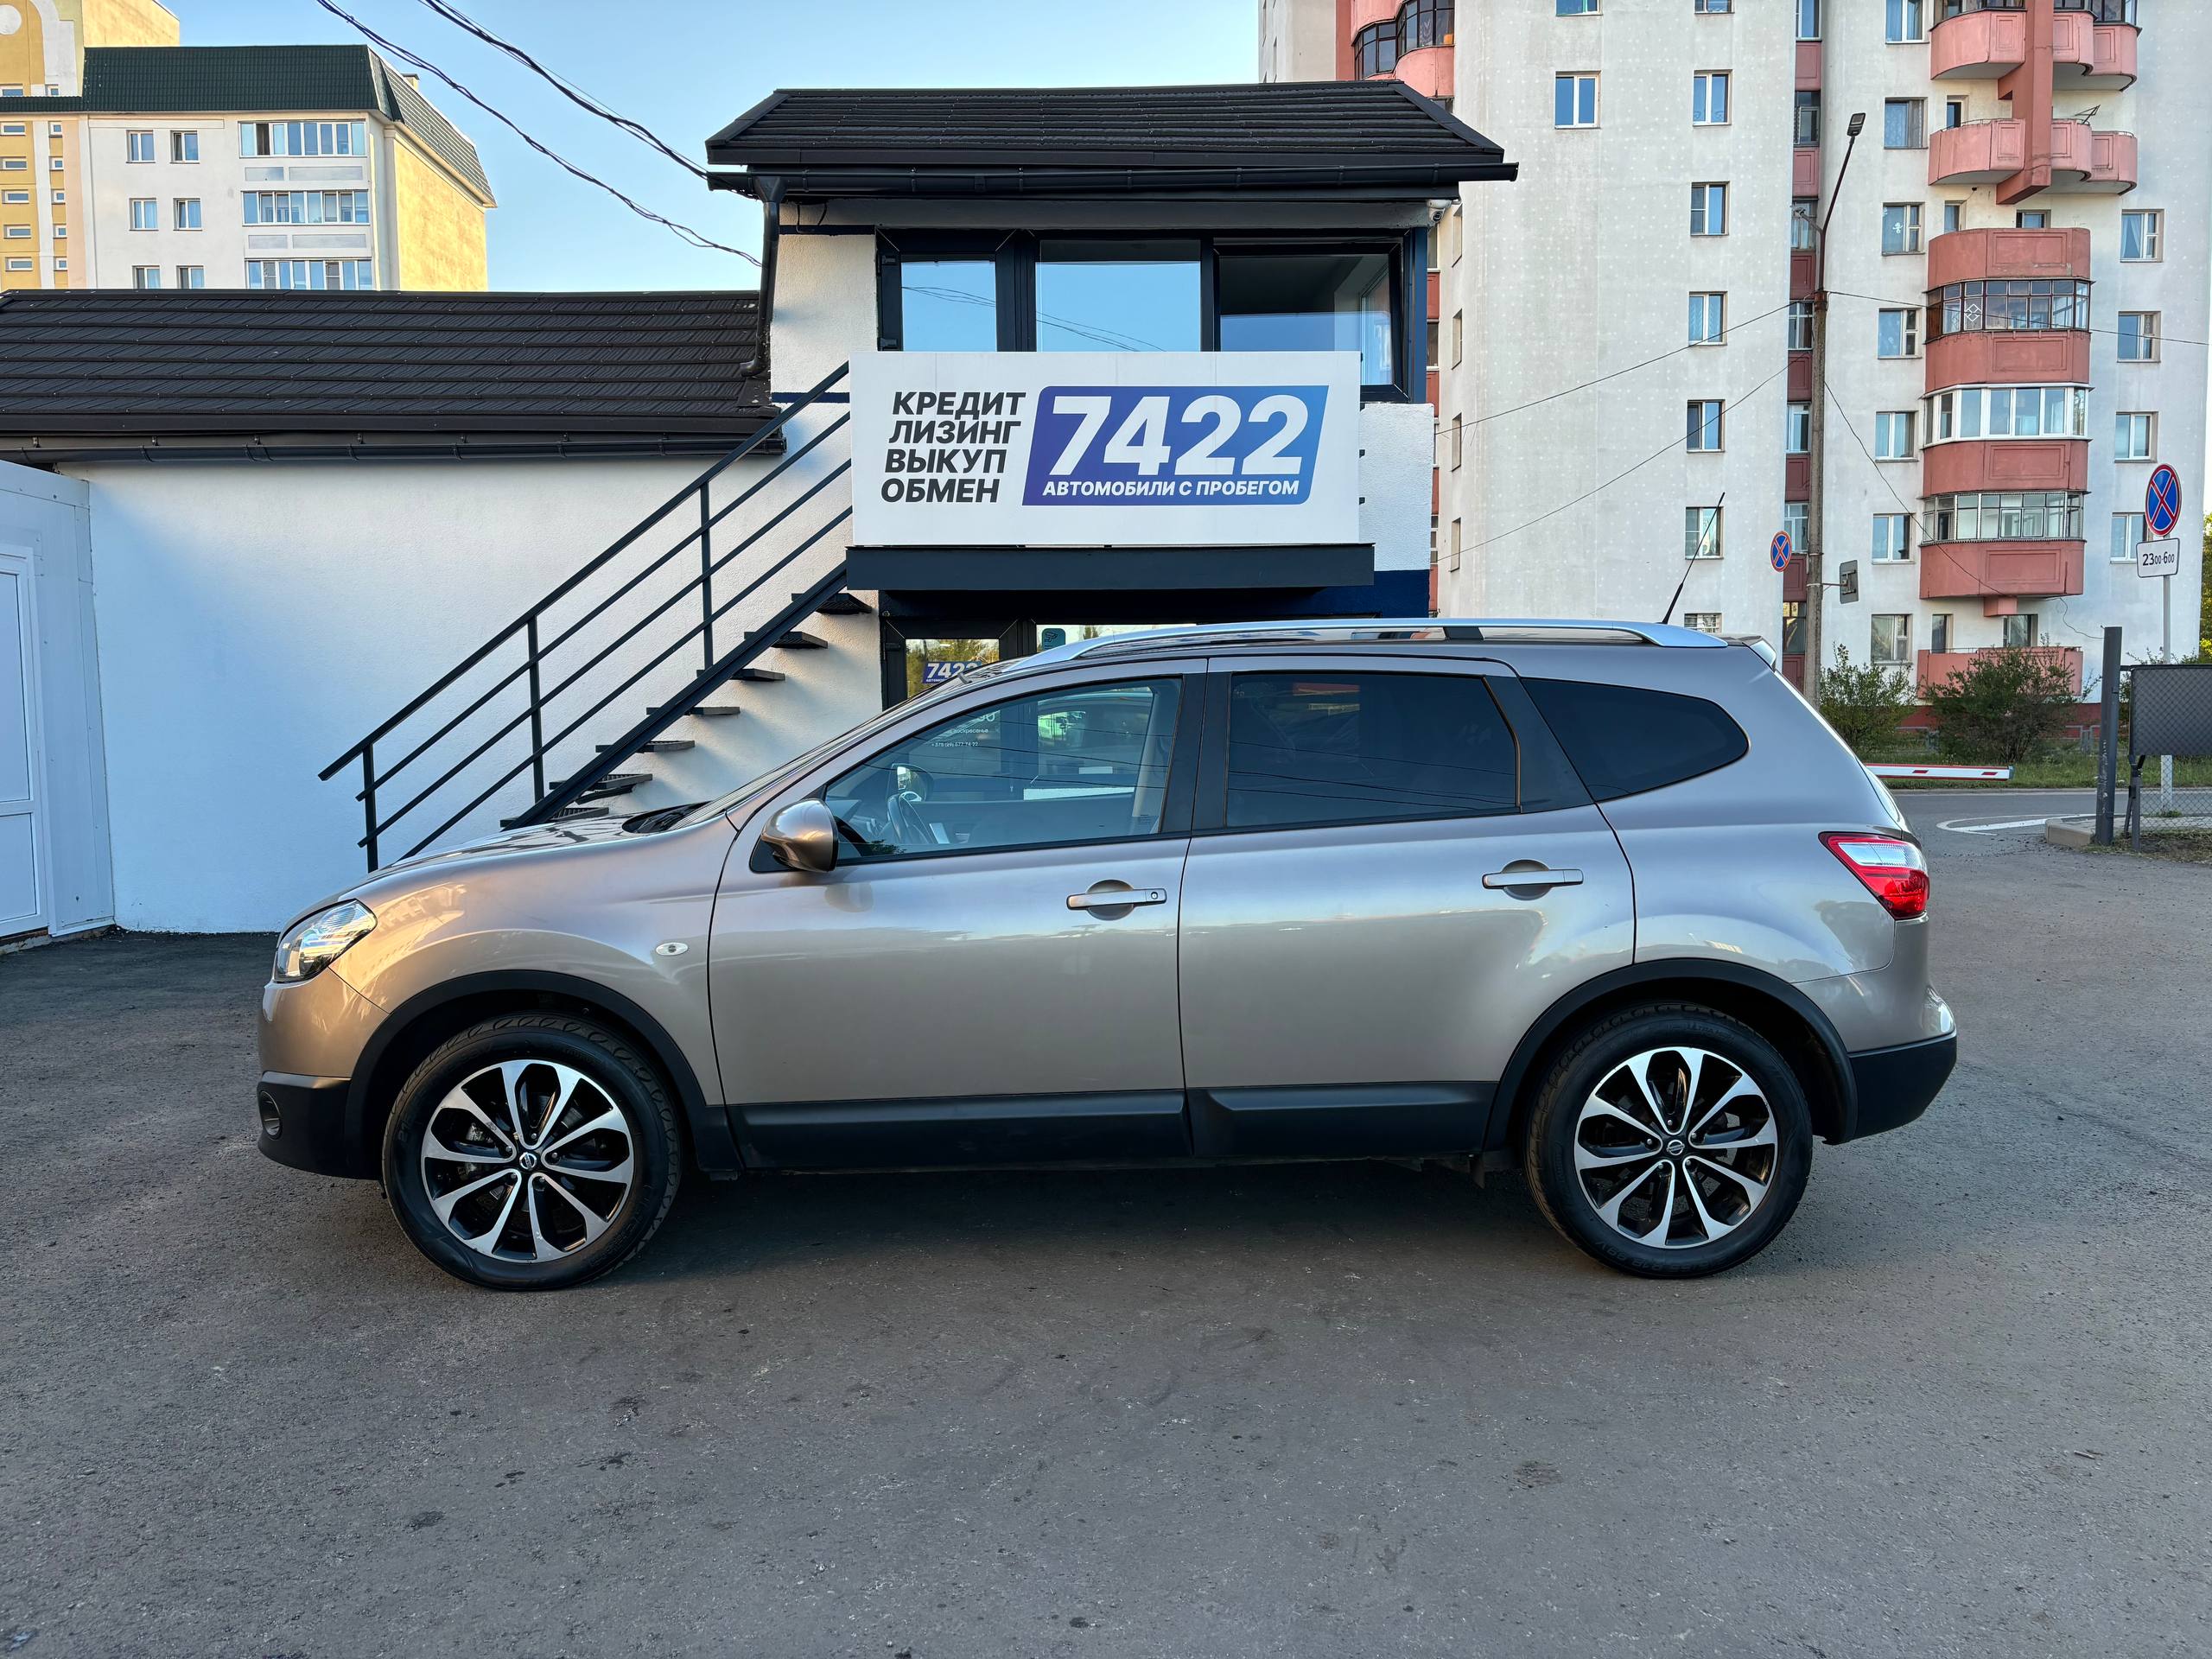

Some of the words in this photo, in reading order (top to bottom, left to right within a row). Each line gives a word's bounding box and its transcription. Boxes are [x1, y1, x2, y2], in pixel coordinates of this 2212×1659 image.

[893, 391, 1027, 420] КРЕДИТ
[888, 421, 1021, 444] ЛИЗИНГ
[1049, 394, 1308, 475] 7422
[885, 449, 1007, 474] ВЫКУП
[880, 478, 1000, 503] ОБМЕН
[1042, 481, 1175, 496] АВТОМОБИЛИ
[1179, 481, 1192, 496] С
[1196, 480, 1300, 495] ПРОБЕГОМ
